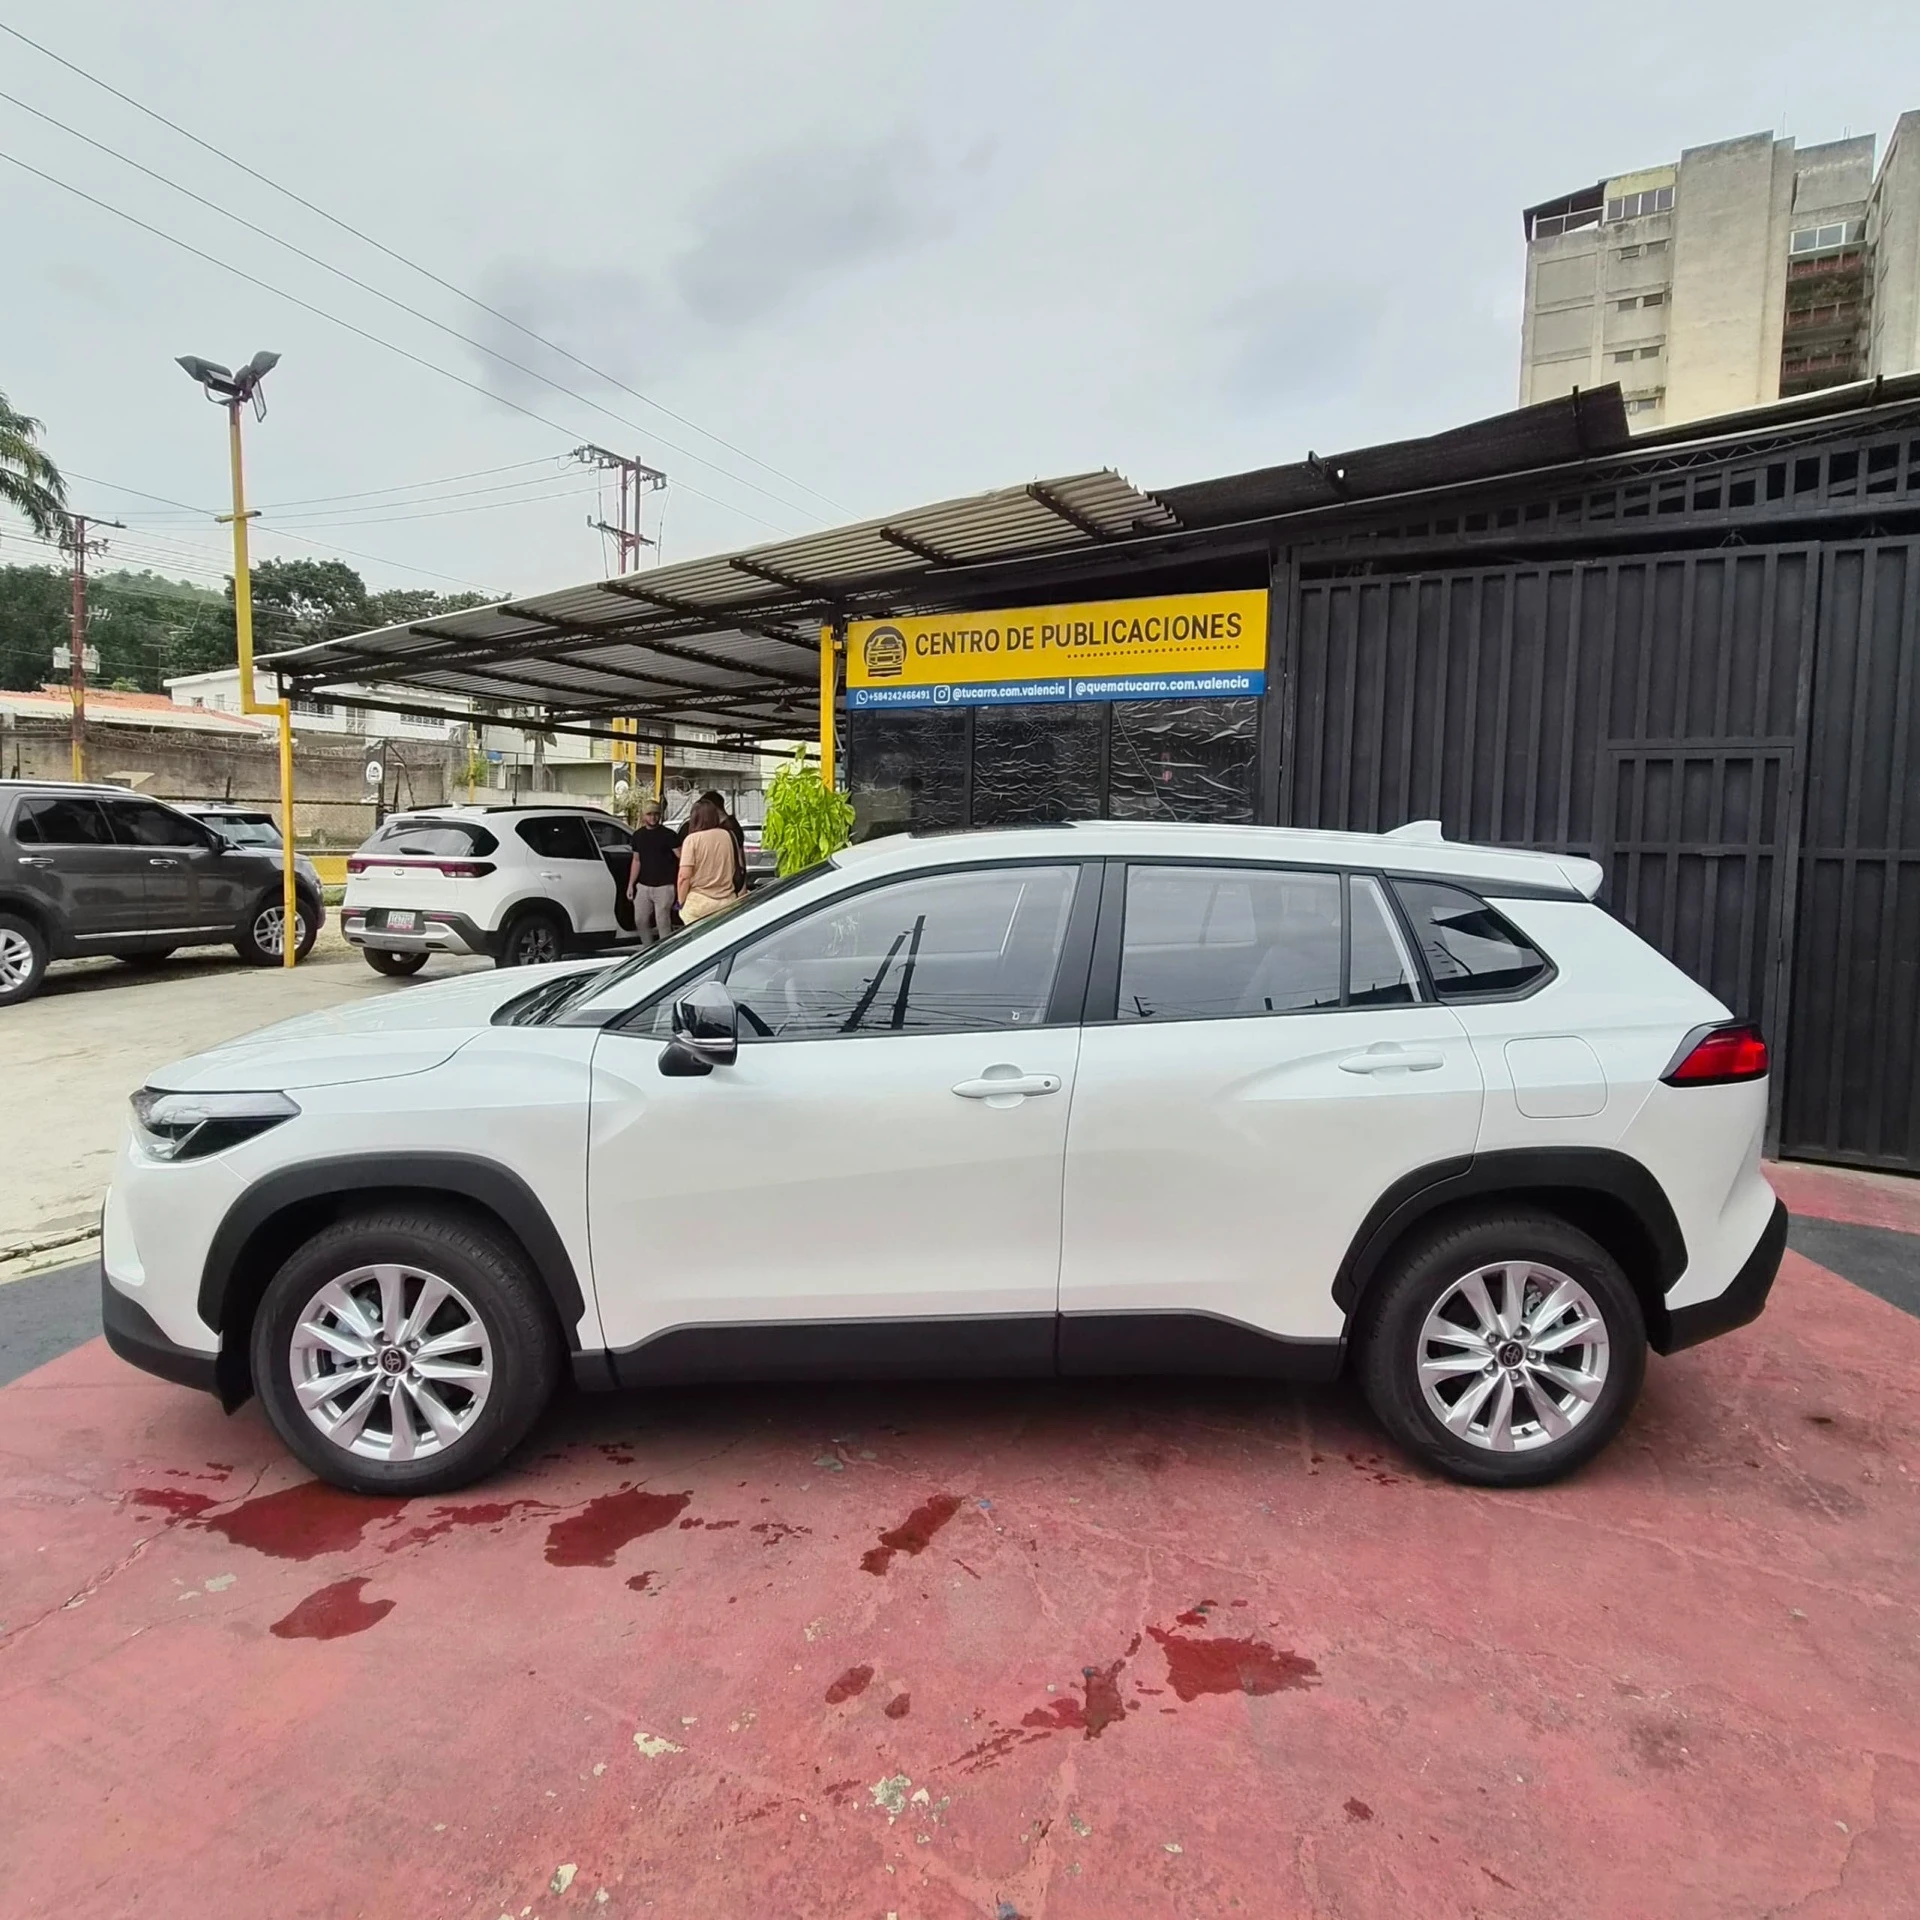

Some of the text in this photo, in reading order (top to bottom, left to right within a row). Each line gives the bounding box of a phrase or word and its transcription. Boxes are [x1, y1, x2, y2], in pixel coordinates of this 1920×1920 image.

[915, 612, 1242, 656] CENTRO DE PUBLICACIONES
[868, 675, 1250, 701] +584242466491 @tucarro.com.valencia @quematucarro.com.valencia
